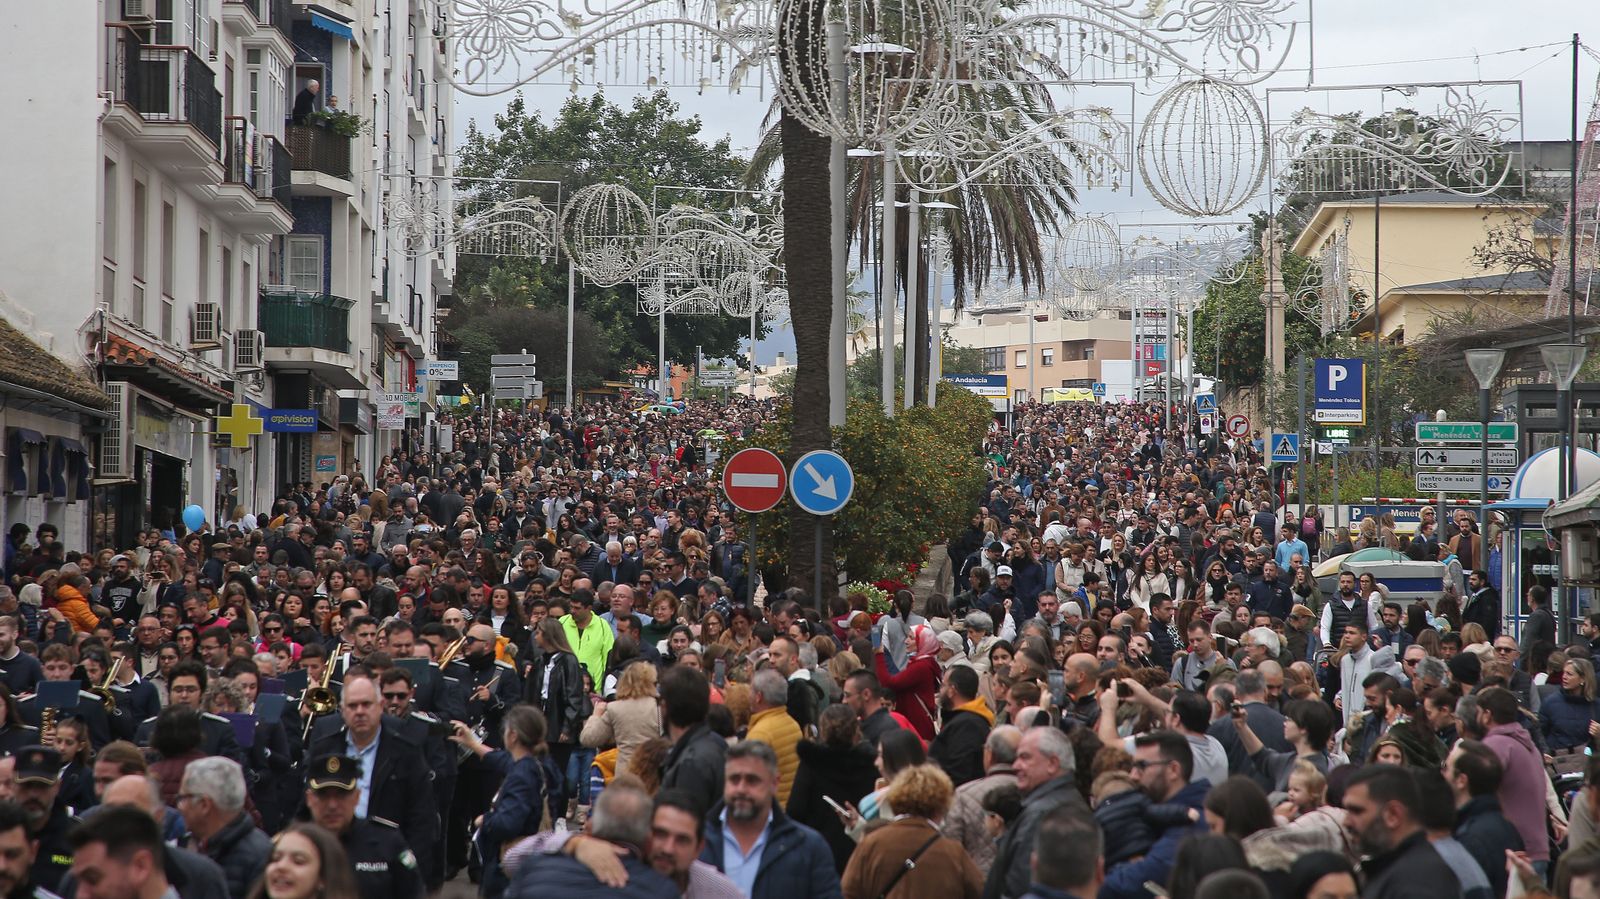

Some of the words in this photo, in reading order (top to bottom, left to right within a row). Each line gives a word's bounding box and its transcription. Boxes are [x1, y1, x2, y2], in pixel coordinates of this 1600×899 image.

[1328, 365, 1348, 391] P
[1326, 429, 1350, 438] LIBRE
[1352, 507, 1361, 520] P
